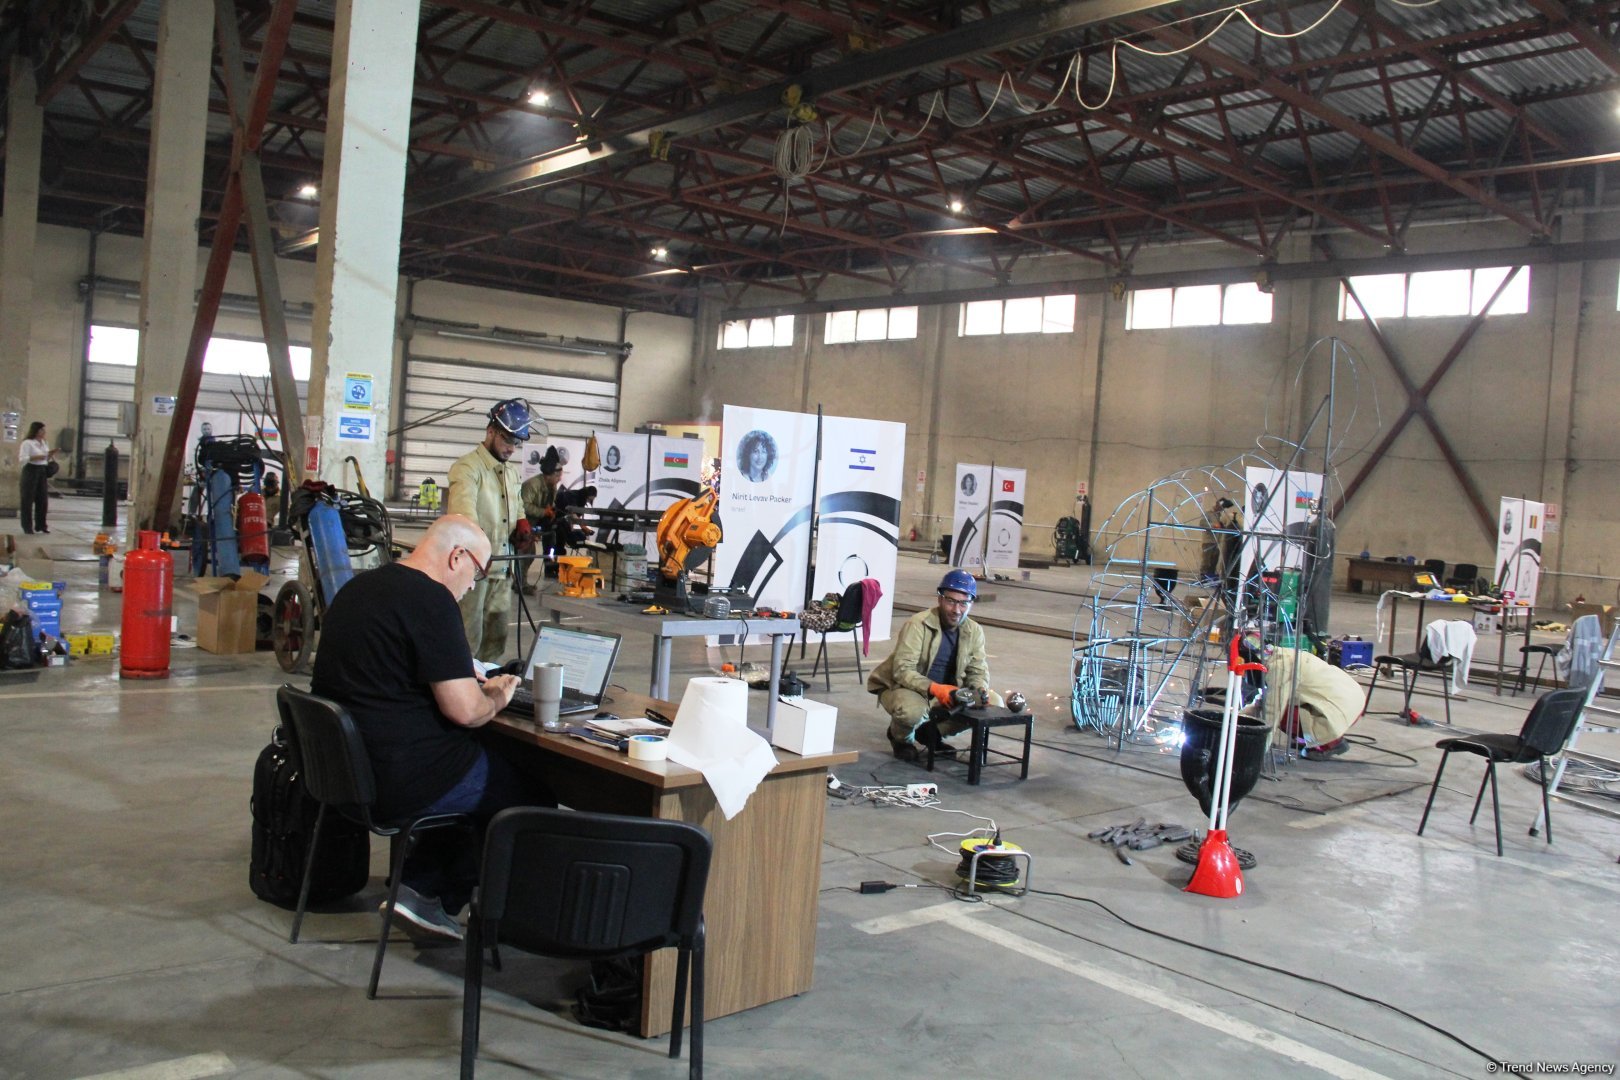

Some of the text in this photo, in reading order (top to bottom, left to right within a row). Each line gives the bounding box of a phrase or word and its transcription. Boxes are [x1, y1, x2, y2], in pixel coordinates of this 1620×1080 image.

[731, 492, 793, 503] Nirit Levav Packer
